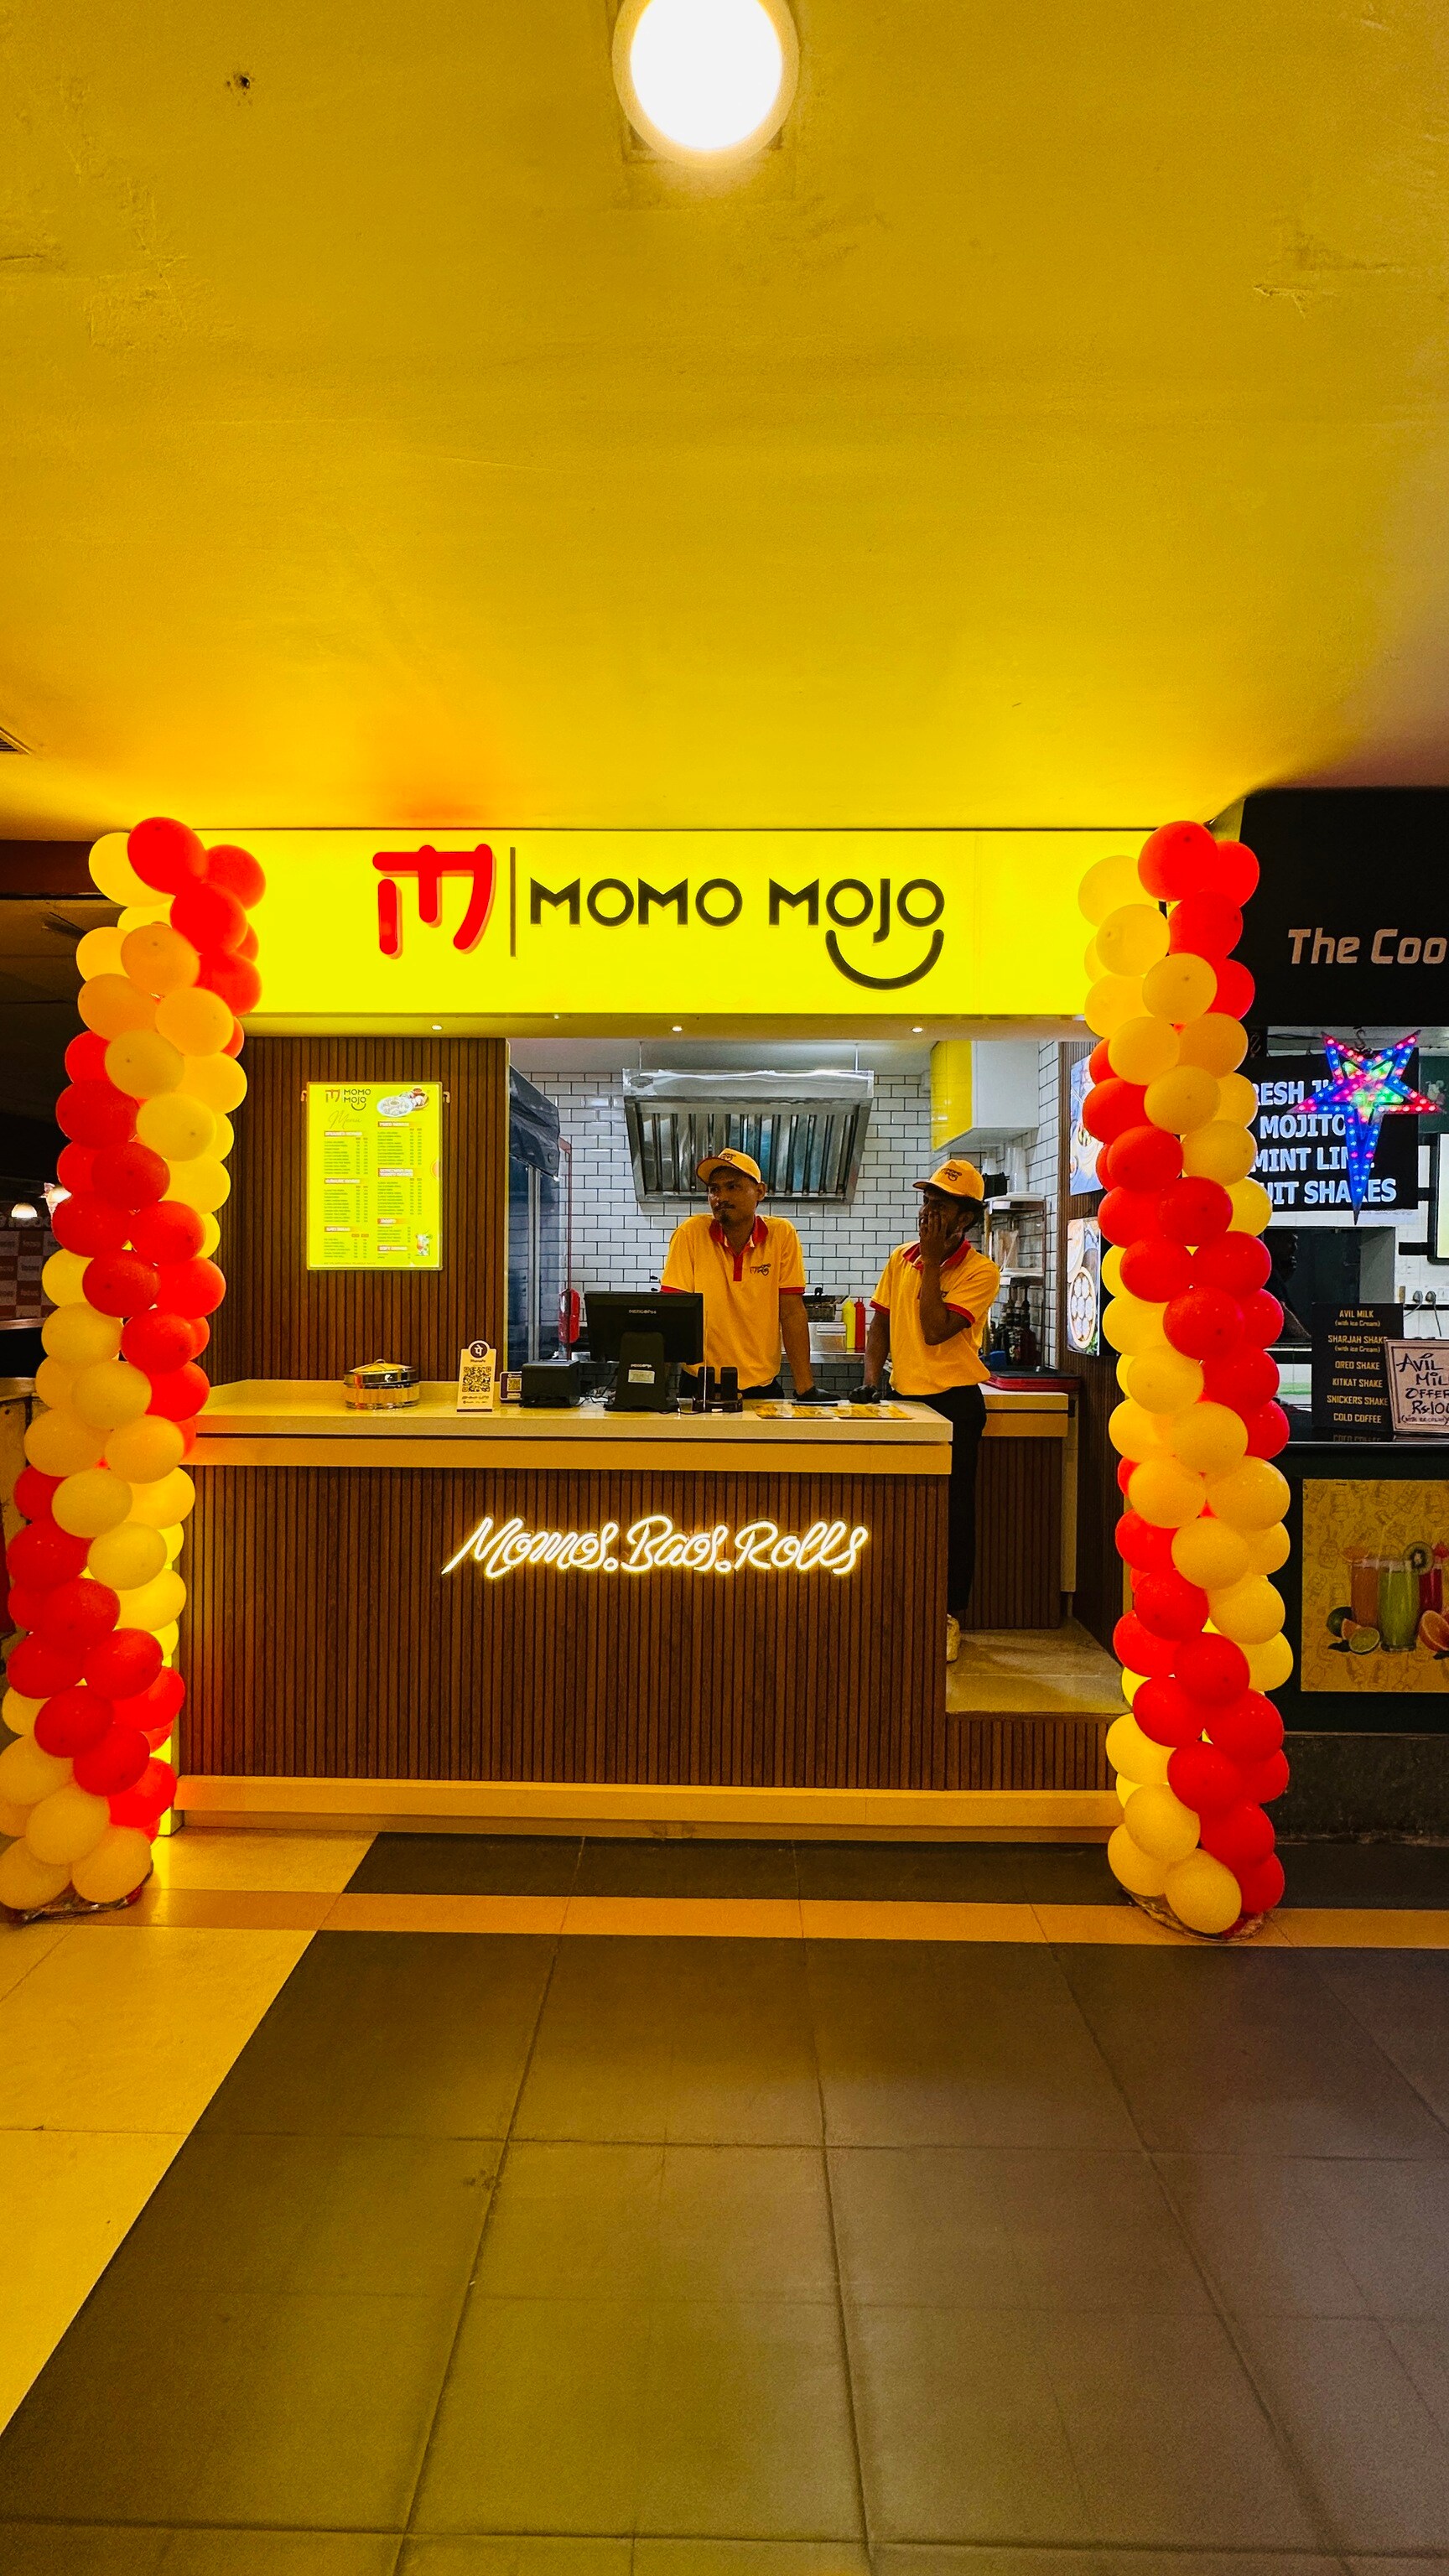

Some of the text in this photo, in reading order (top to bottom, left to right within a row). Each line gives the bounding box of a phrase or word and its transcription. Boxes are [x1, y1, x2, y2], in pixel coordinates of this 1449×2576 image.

[529, 877, 945, 945] MOMO MOJO
[1288, 927, 1360, 964] The
[343, 1096, 366, 1105] MOJO
[328, 1109, 362, 1129] Menu
[1304, 1178, 1397, 1204] SHAES
[1357, 1310, 1374, 1318] MILK
[1327, 1335, 1362, 1344] SHARJAH
[1335, 1360, 1380, 1370] OREO SHAKE
[1332, 1378, 1384, 1388] KITKAT SHAKE
[1327, 1394, 1389, 1406] SNICKERS SHAKE
[1333, 1412, 1382, 1424] COLD COFFEE
[733, 1519, 870, 1575] Rolls
